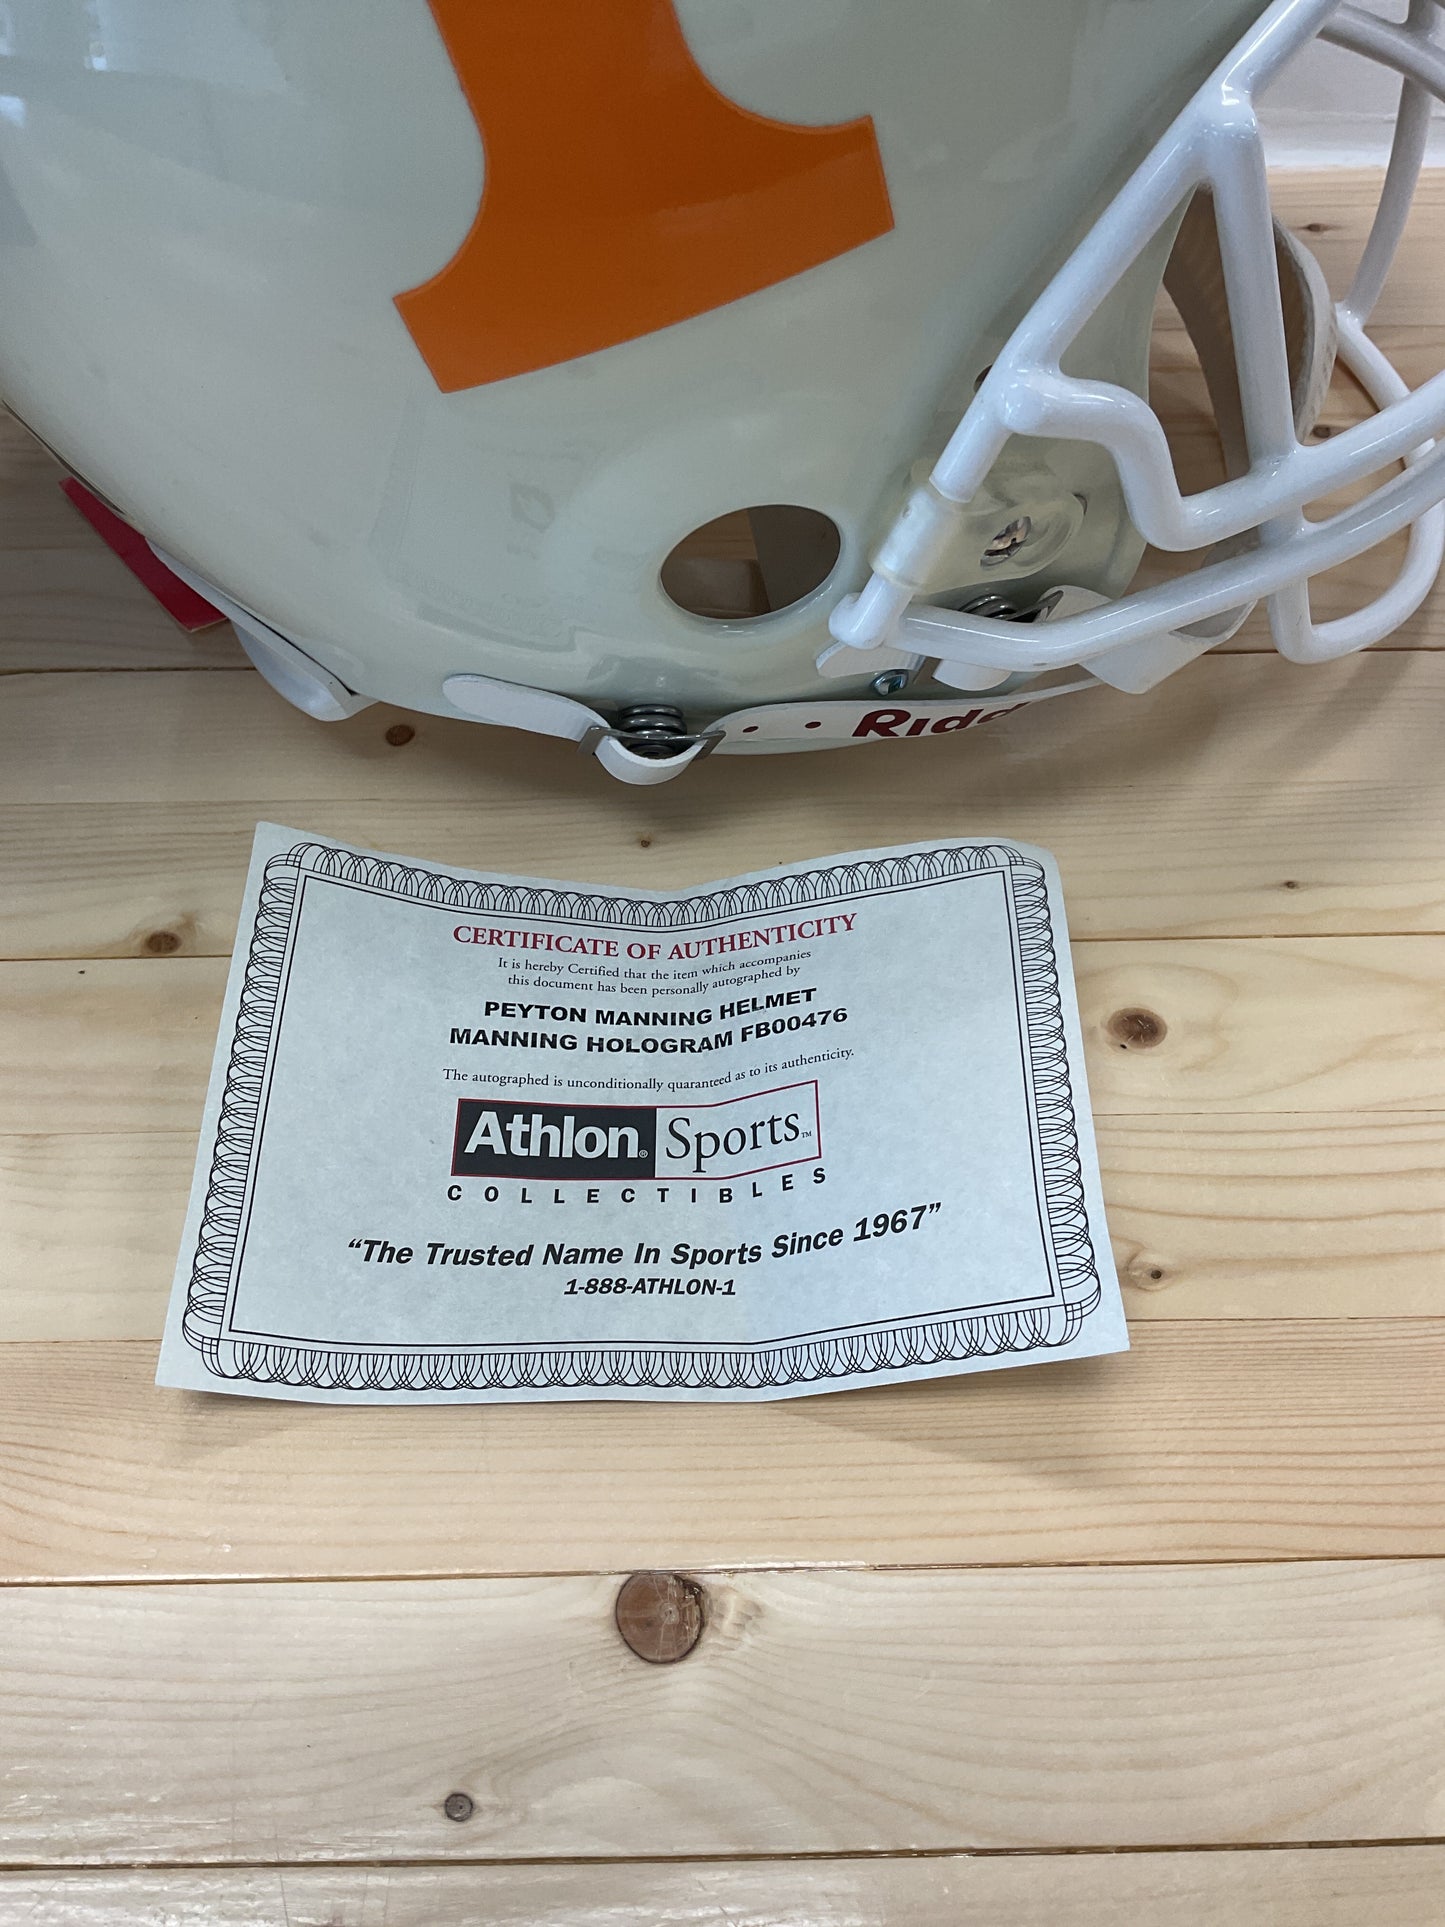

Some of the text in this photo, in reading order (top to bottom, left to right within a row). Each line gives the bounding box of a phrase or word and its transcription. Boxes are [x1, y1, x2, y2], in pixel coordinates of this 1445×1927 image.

[453, 913, 857, 960] CERTIFICATE OF AUTHENTICITY
[498, 950, 811, 980] It is hereby Certified that the item which accompanies
[508, 966, 800, 998] this document has been personally autographed by
[484, 988, 817, 1026] PEYTON MANNING HELMET
[450, 1007, 848, 1054] MANNING HOLOGRAM FB00476
[443, 1047, 855, 1092] The autographed is unconditionally quaranteed as to its authenticity.
[447, 1167, 826, 1204] COLLECTIBLES
[426, 1242, 535, 1266] Trusted
[542, 1243, 623, 1265] Name
[634, 1243, 660, 1264] In
[670, 1243, 762, 1269] Sports
[771, 1228, 843, 1258] Since
[564, 1278, 736, 1295] 1-888-ATHLON-1
